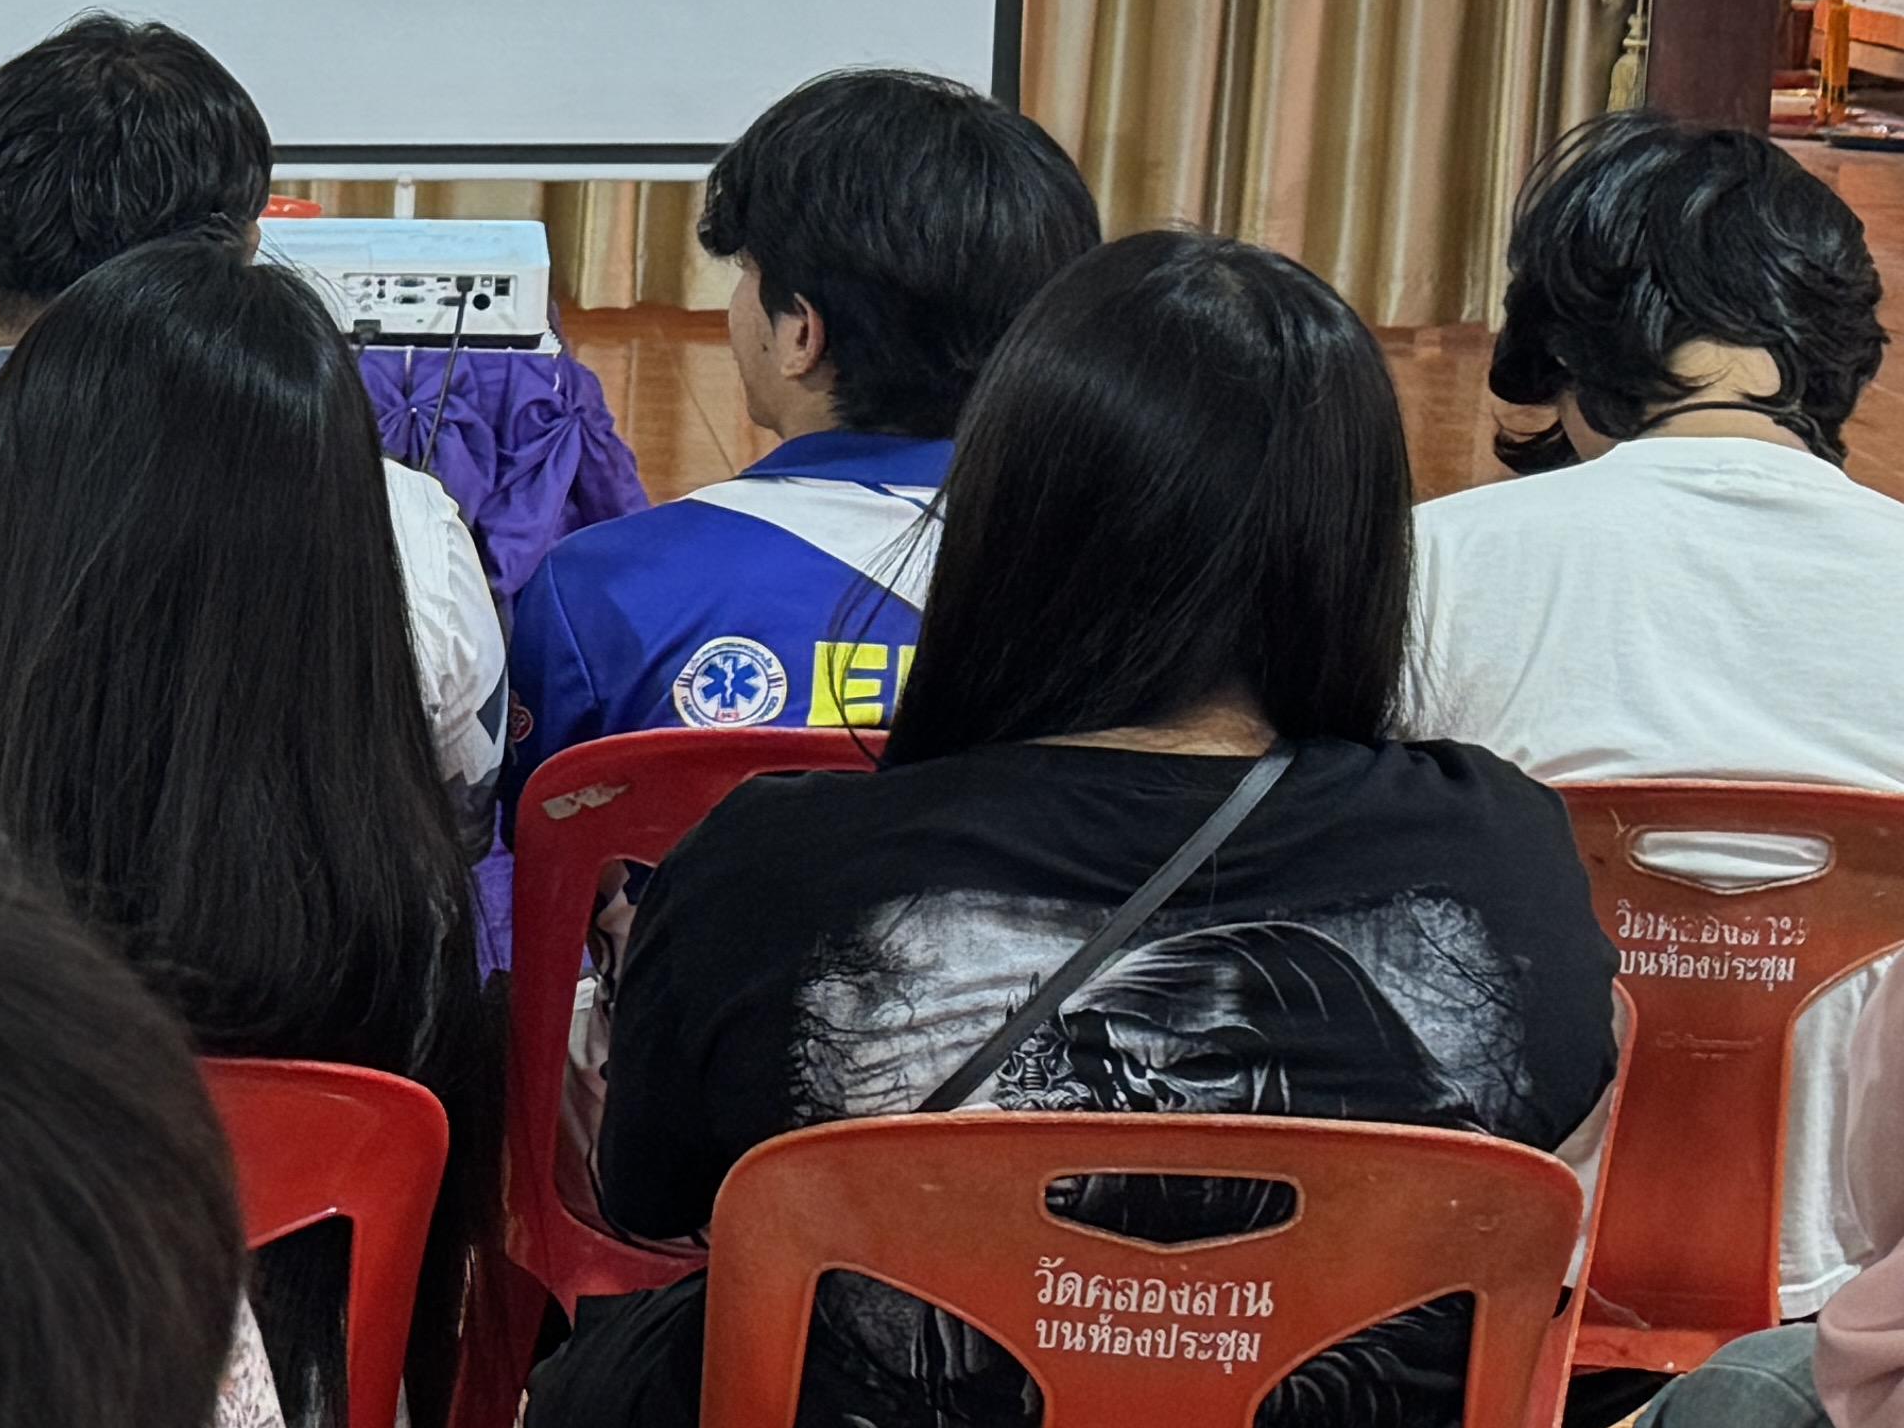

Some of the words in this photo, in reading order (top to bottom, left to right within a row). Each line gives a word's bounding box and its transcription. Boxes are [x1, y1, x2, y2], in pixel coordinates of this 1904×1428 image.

[1618, 945, 1797, 992] บนห้องประชุม
[1034, 1256, 1274, 1318] วัดคลองลาน
[1035, 1313, 1261, 1374] บนห้องประชุม
